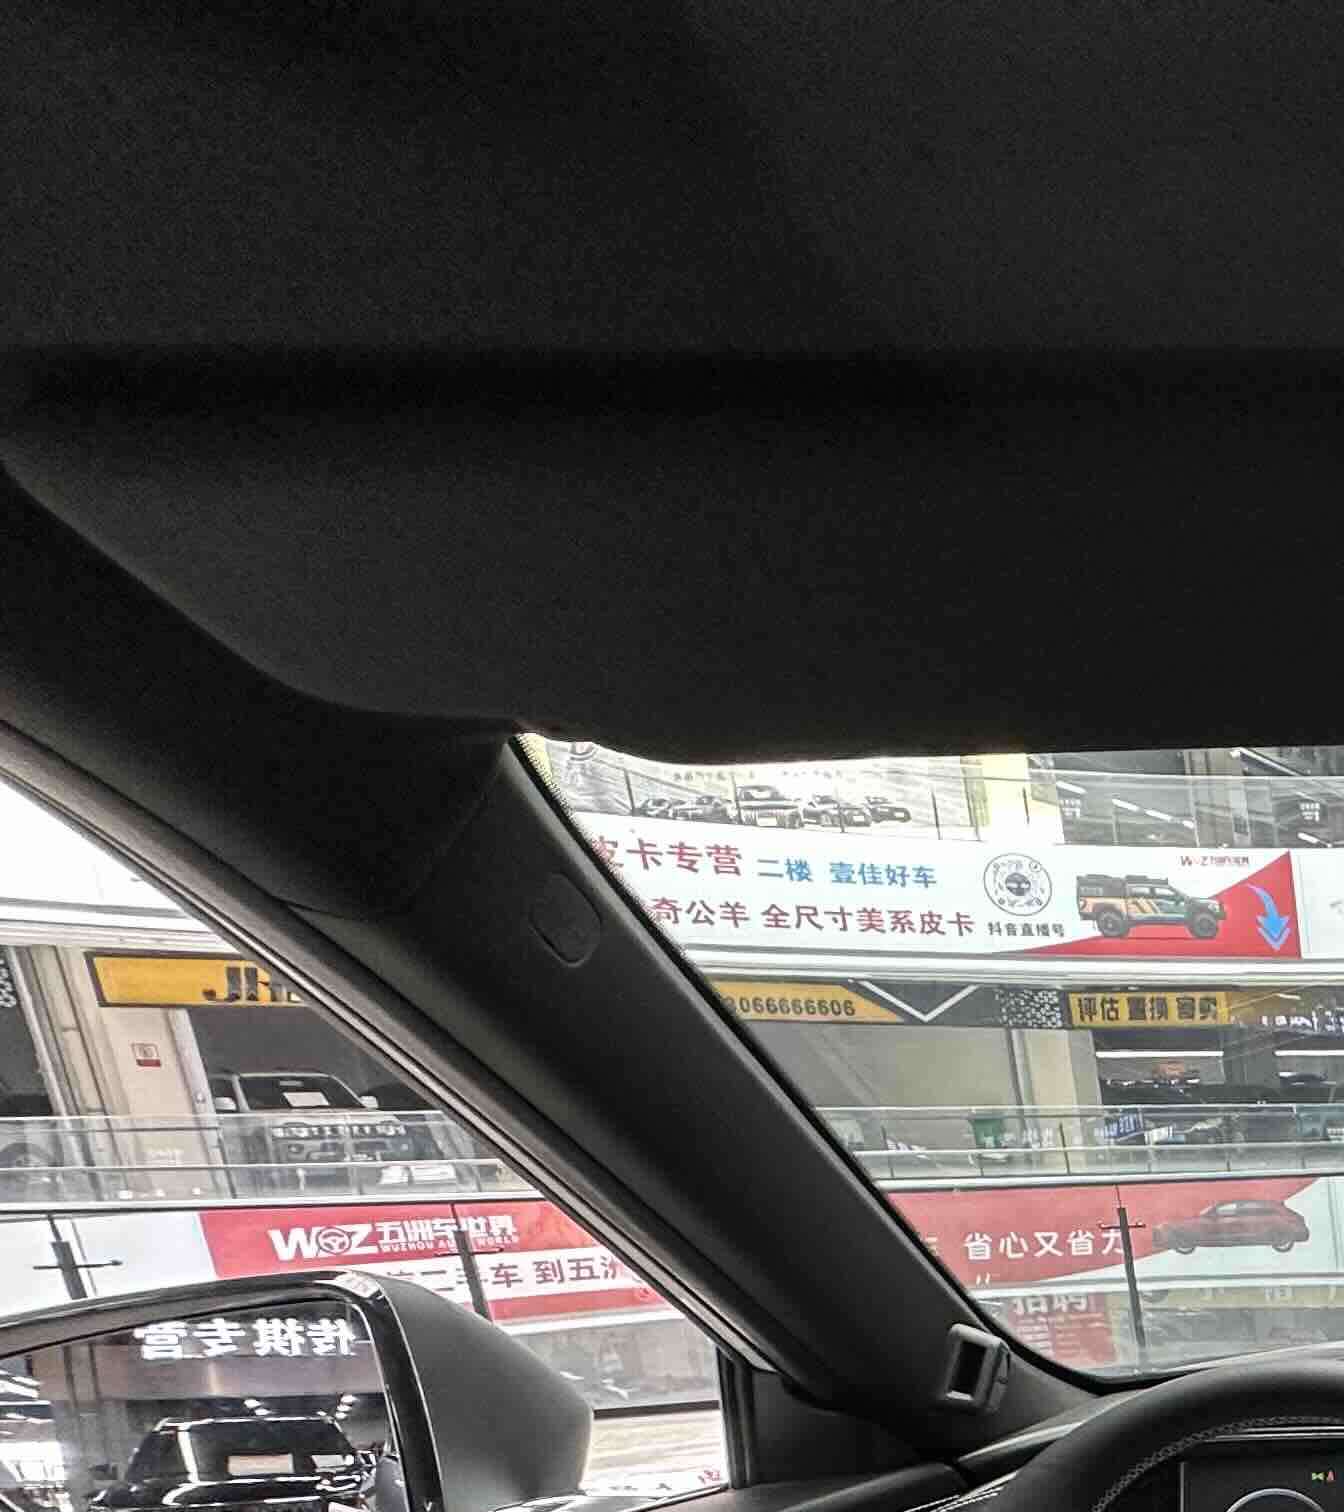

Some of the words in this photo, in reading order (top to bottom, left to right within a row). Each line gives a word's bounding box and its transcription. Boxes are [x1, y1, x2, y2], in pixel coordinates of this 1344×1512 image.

[757, 858, 813, 883] 二楼
[829, 862, 938, 888] 壹佳好车
[761, 903, 976, 936] 全尺寸美系皮卡
[964, 1229, 1124, 1261] 省心又省力
